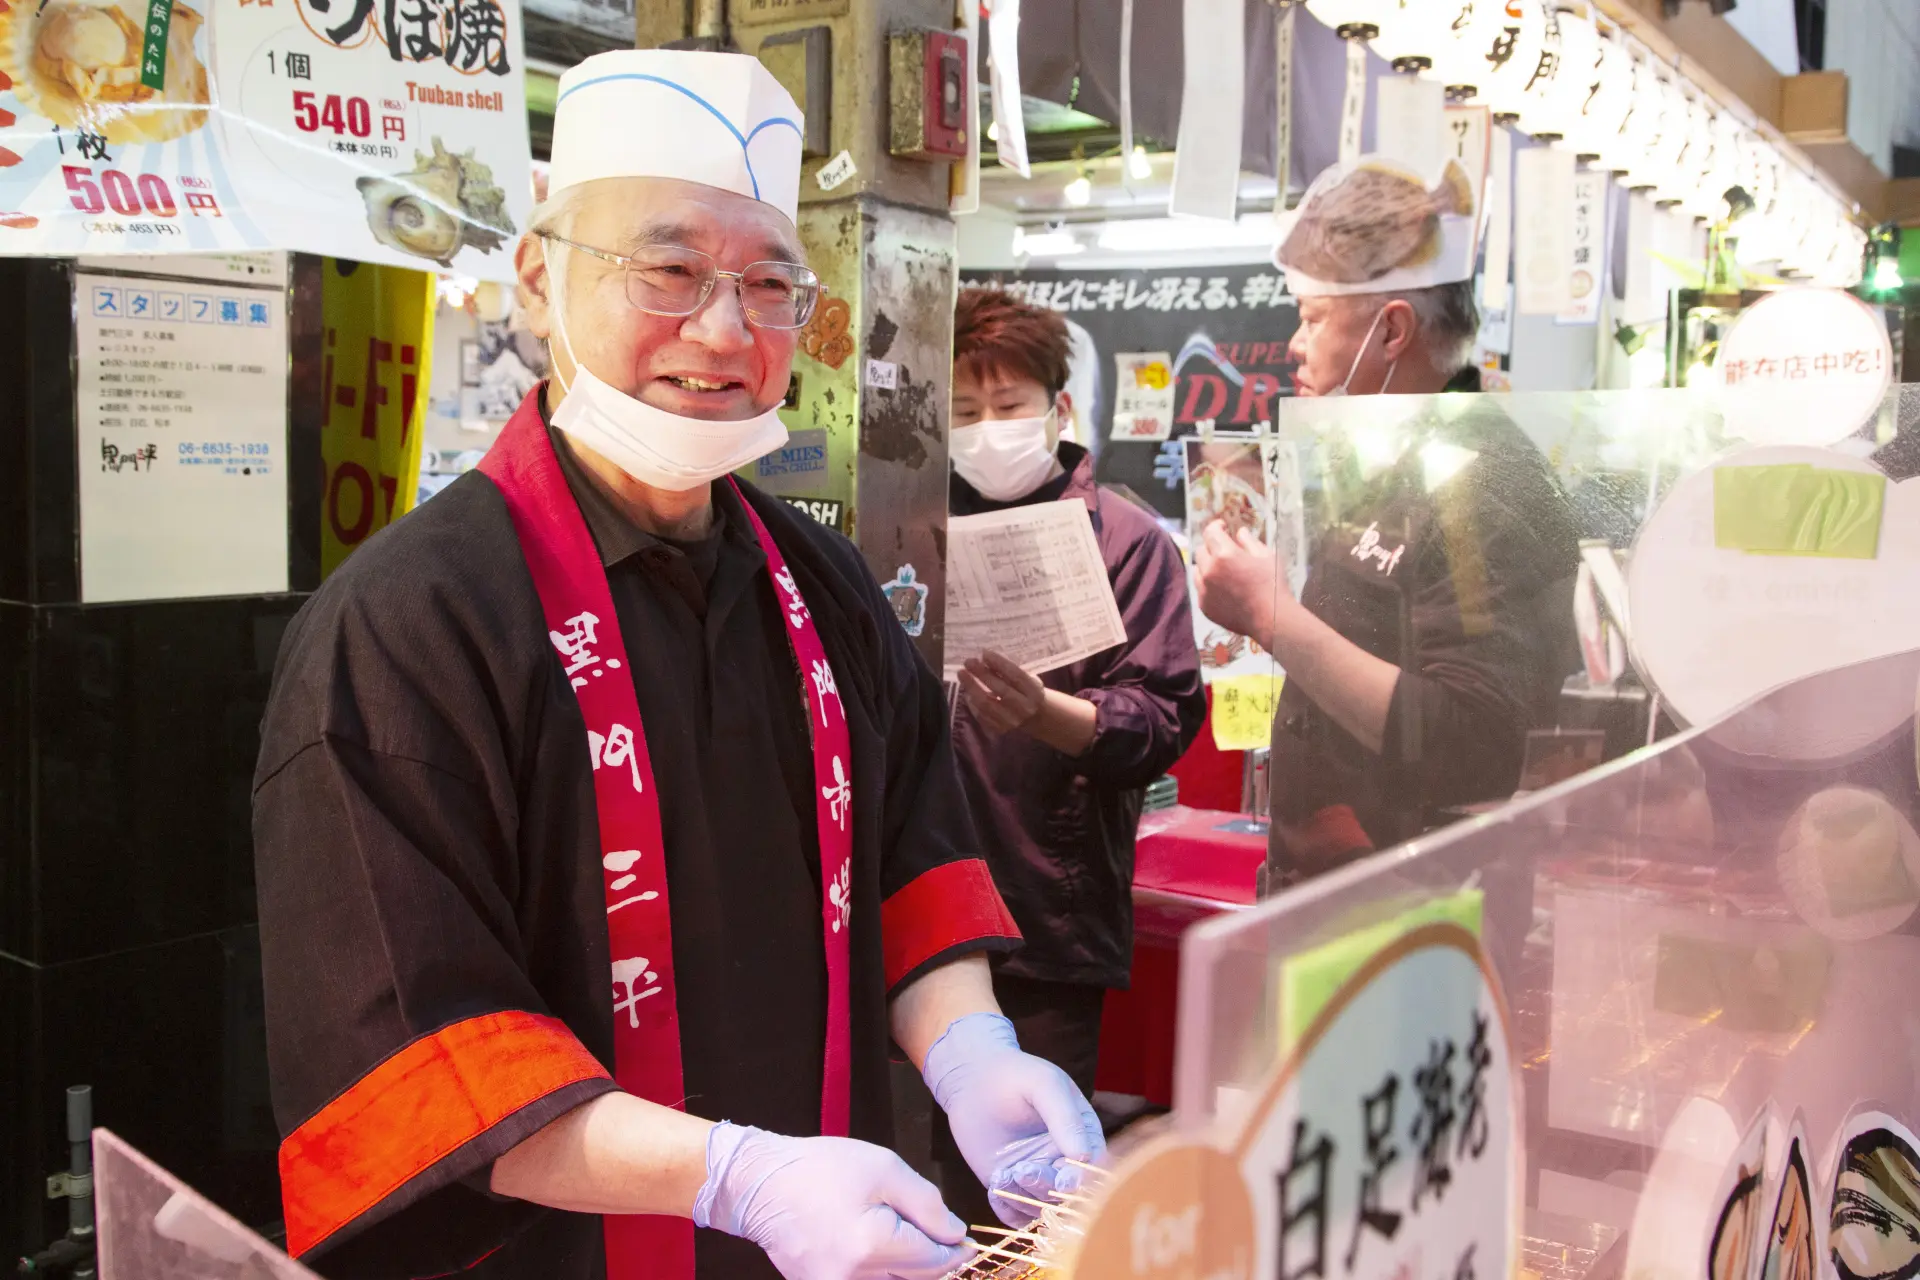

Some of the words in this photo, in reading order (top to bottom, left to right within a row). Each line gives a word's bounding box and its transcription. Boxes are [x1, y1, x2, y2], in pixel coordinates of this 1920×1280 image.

[146, 0, 169, 75] 伝のたれ
[292, 90, 371, 138] 540
[382, 115, 406, 142] 円
[466, 89, 503, 112] shell
[61, 165, 178, 218] 500
[184, 192, 223, 218] 円
[98, 292, 268, 324] スタッフ募集
